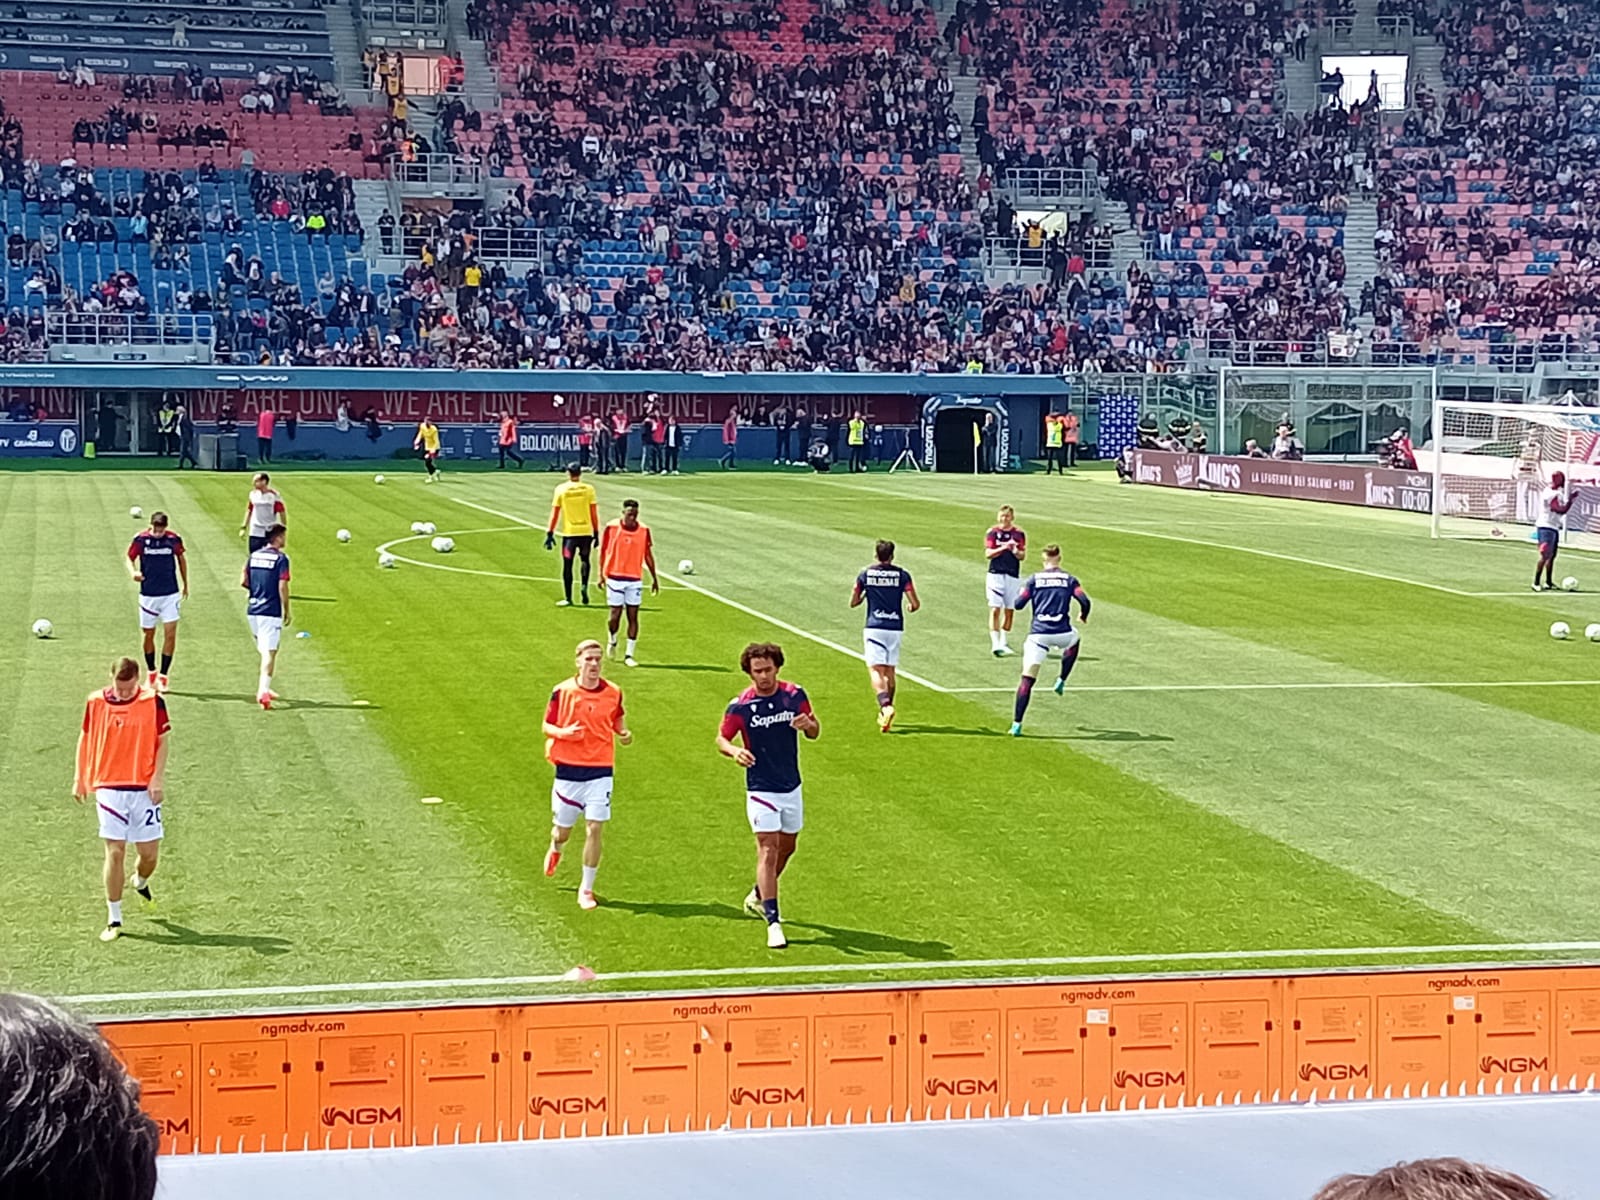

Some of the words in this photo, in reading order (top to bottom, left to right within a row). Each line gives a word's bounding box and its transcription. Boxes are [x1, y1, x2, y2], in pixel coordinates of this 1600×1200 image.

[243, 391, 293, 414] ARE
[383, 392, 420, 416] WE
[427, 392, 475, 416] ARE
[481, 393, 529, 416] ONE
[519, 435, 573, 452] BOLOGNA
[925, 425, 935, 465] macron
[1000, 428, 1009, 468] macron
[1198, 454, 1241, 489] KING'S
[1364, 472, 1395, 505] KING'S
[1401, 490, 1431, 512] 00:00
[750, 710, 796, 729] Saputo
[1428, 975, 1500, 991] ngmadv.com
[1061, 987, 1136, 1004] ngmadv.com
[673, 1002, 752, 1019] ngmadv.com
[261, 1019, 346, 1037] ngmadv.com
[1311, 1064, 1369, 1081] NGM
[1492, 1056, 1549, 1074] NGM
[938, 1078, 998, 1096] NGM
[1127, 1070, 1186, 1089] NGM
[541, 1096, 607, 1115] NGM
[742, 1087, 805, 1105] NGM
[335, 1106, 401, 1126] NGM
